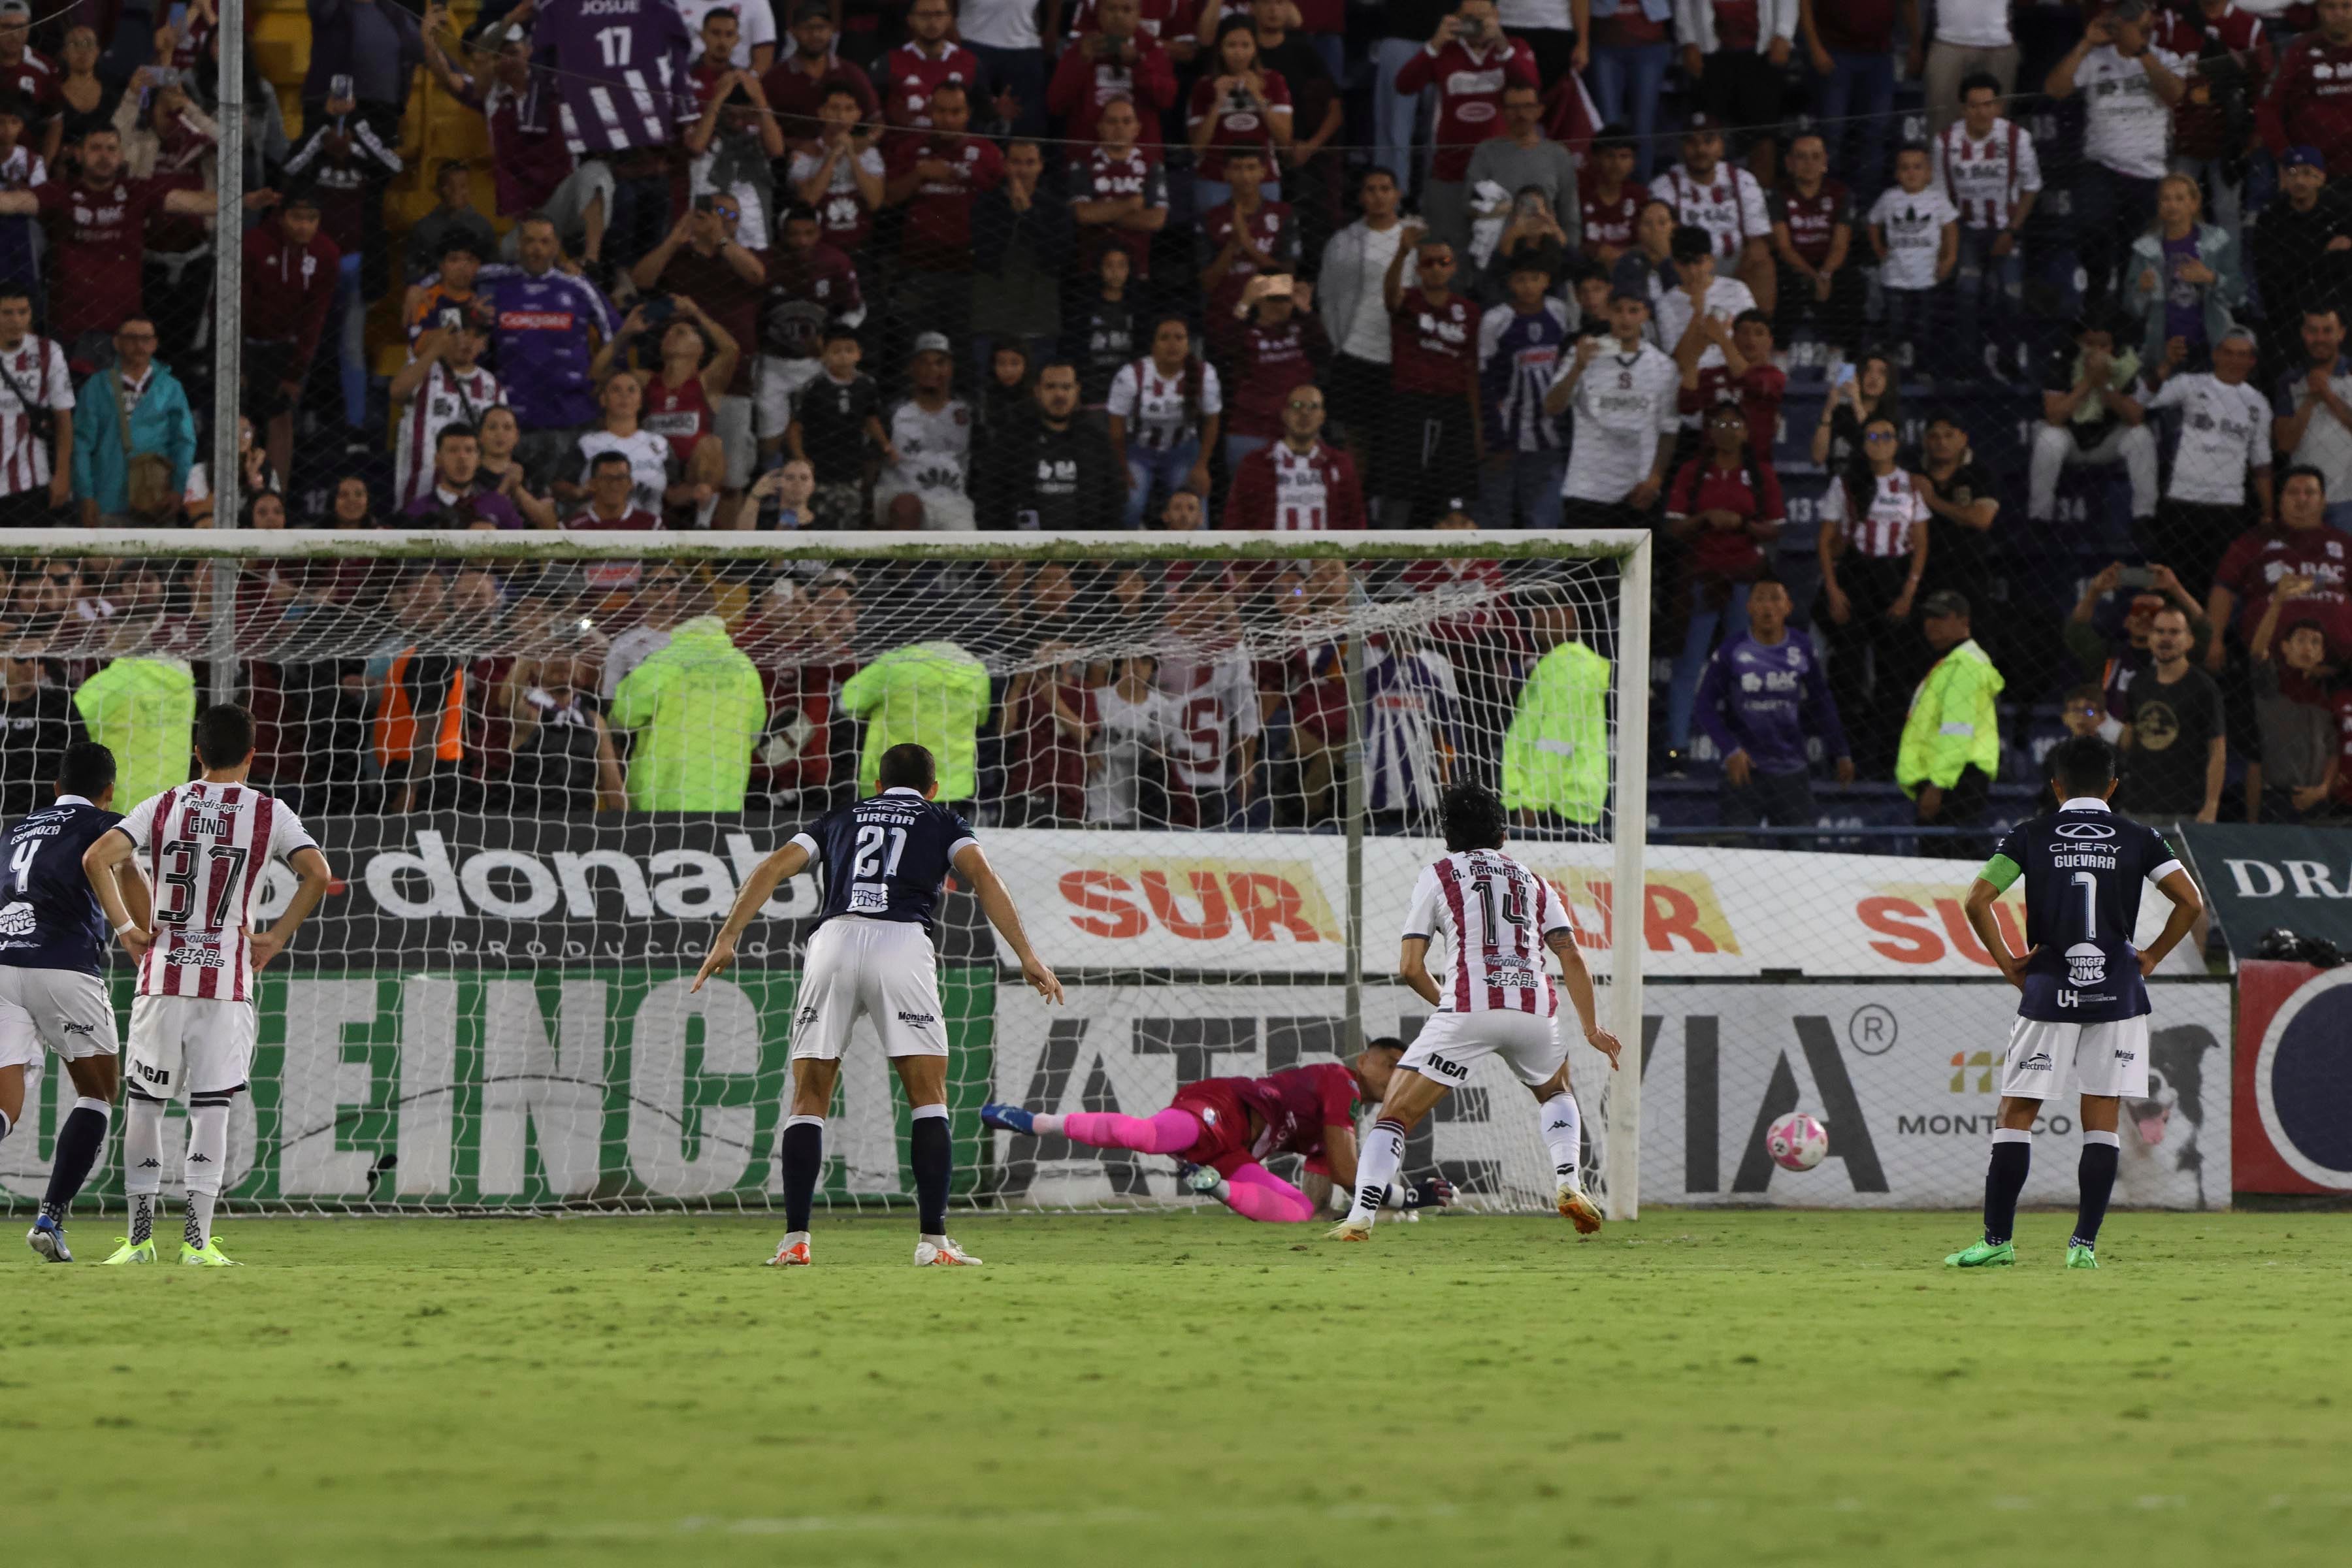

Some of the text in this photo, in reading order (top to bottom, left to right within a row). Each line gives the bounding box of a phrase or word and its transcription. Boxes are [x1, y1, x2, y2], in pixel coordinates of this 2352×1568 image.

[595, 25, 632, 67] 17
[189, 798, 244, 813] medismart
[853, 806, 925, 815] CHERY
[189, 816, 227, 837] GINO
[852, 825, 907, 879] 21
[2049, 842, 2121, 854] CHERY
[9, 839, 42, 894] 4
[2054, 854, 2116, 870] GUEVARA
[1451, 865, 1533, 883] A. FRANCISC
[157, 840, 248, 928] 37
[1058, 870, 1320, 943] SUR
[1471, 880, 1531, 947] 14
[1856, 896, 2028, 968] SU
[175, 948, 220, 958] STAR
[179, 956, 225, 968] CARS
[1492, 972, 1534, 981] STAR
[1499, 979, 1539, 988] CARS
[2057, 989, 2078, 1007] UH
[898, 1011, 934, 1022] Montaña
[1427, 1052, 1469, 1081] RCA
[1898, 1114, 2071, 1135] MONTCO
